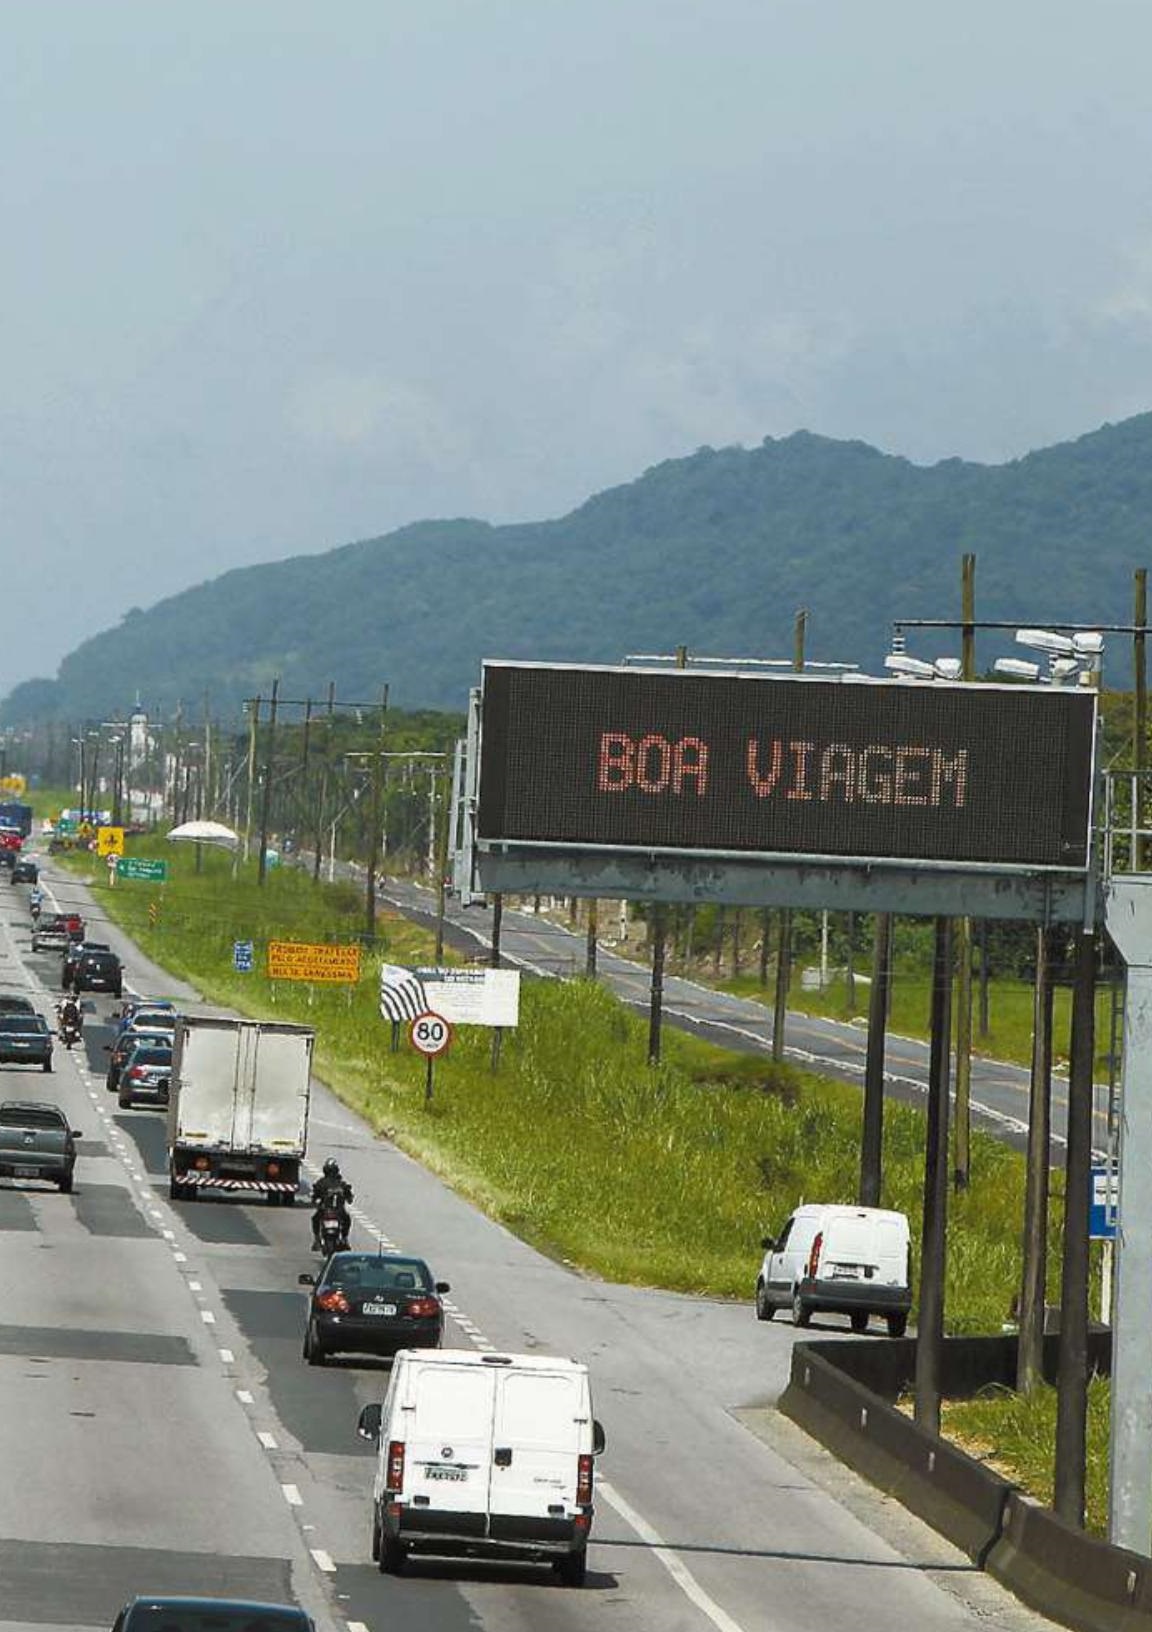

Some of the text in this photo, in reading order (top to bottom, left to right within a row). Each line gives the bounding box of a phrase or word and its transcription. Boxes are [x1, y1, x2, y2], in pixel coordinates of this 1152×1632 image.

[597, 732, 969, 808] BOA VIAGEM
[417, 1022, 444, 1042] 80
